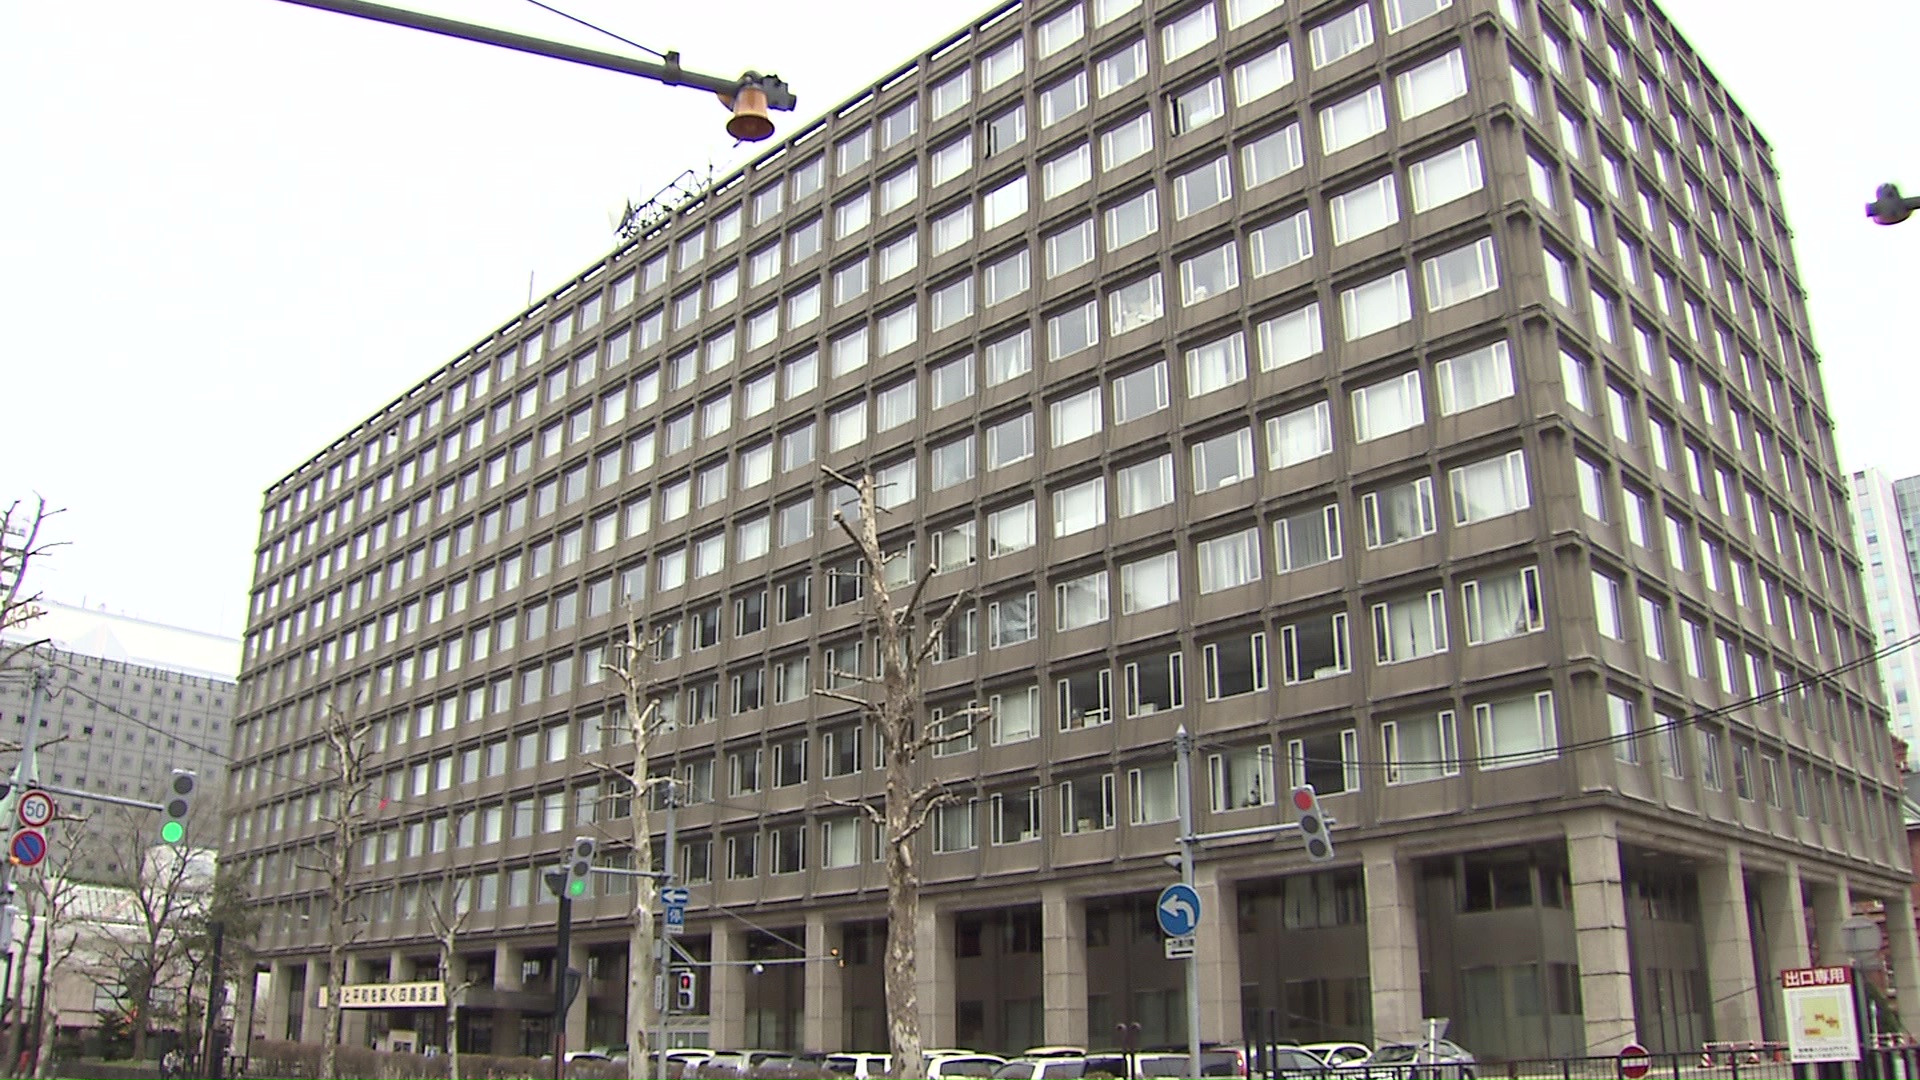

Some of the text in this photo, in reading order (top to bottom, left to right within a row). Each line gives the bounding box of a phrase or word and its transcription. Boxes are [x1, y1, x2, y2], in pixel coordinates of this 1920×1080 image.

[25, 801, 46, 818] 50
[1785, 967, 1845, 987] 出口専用
